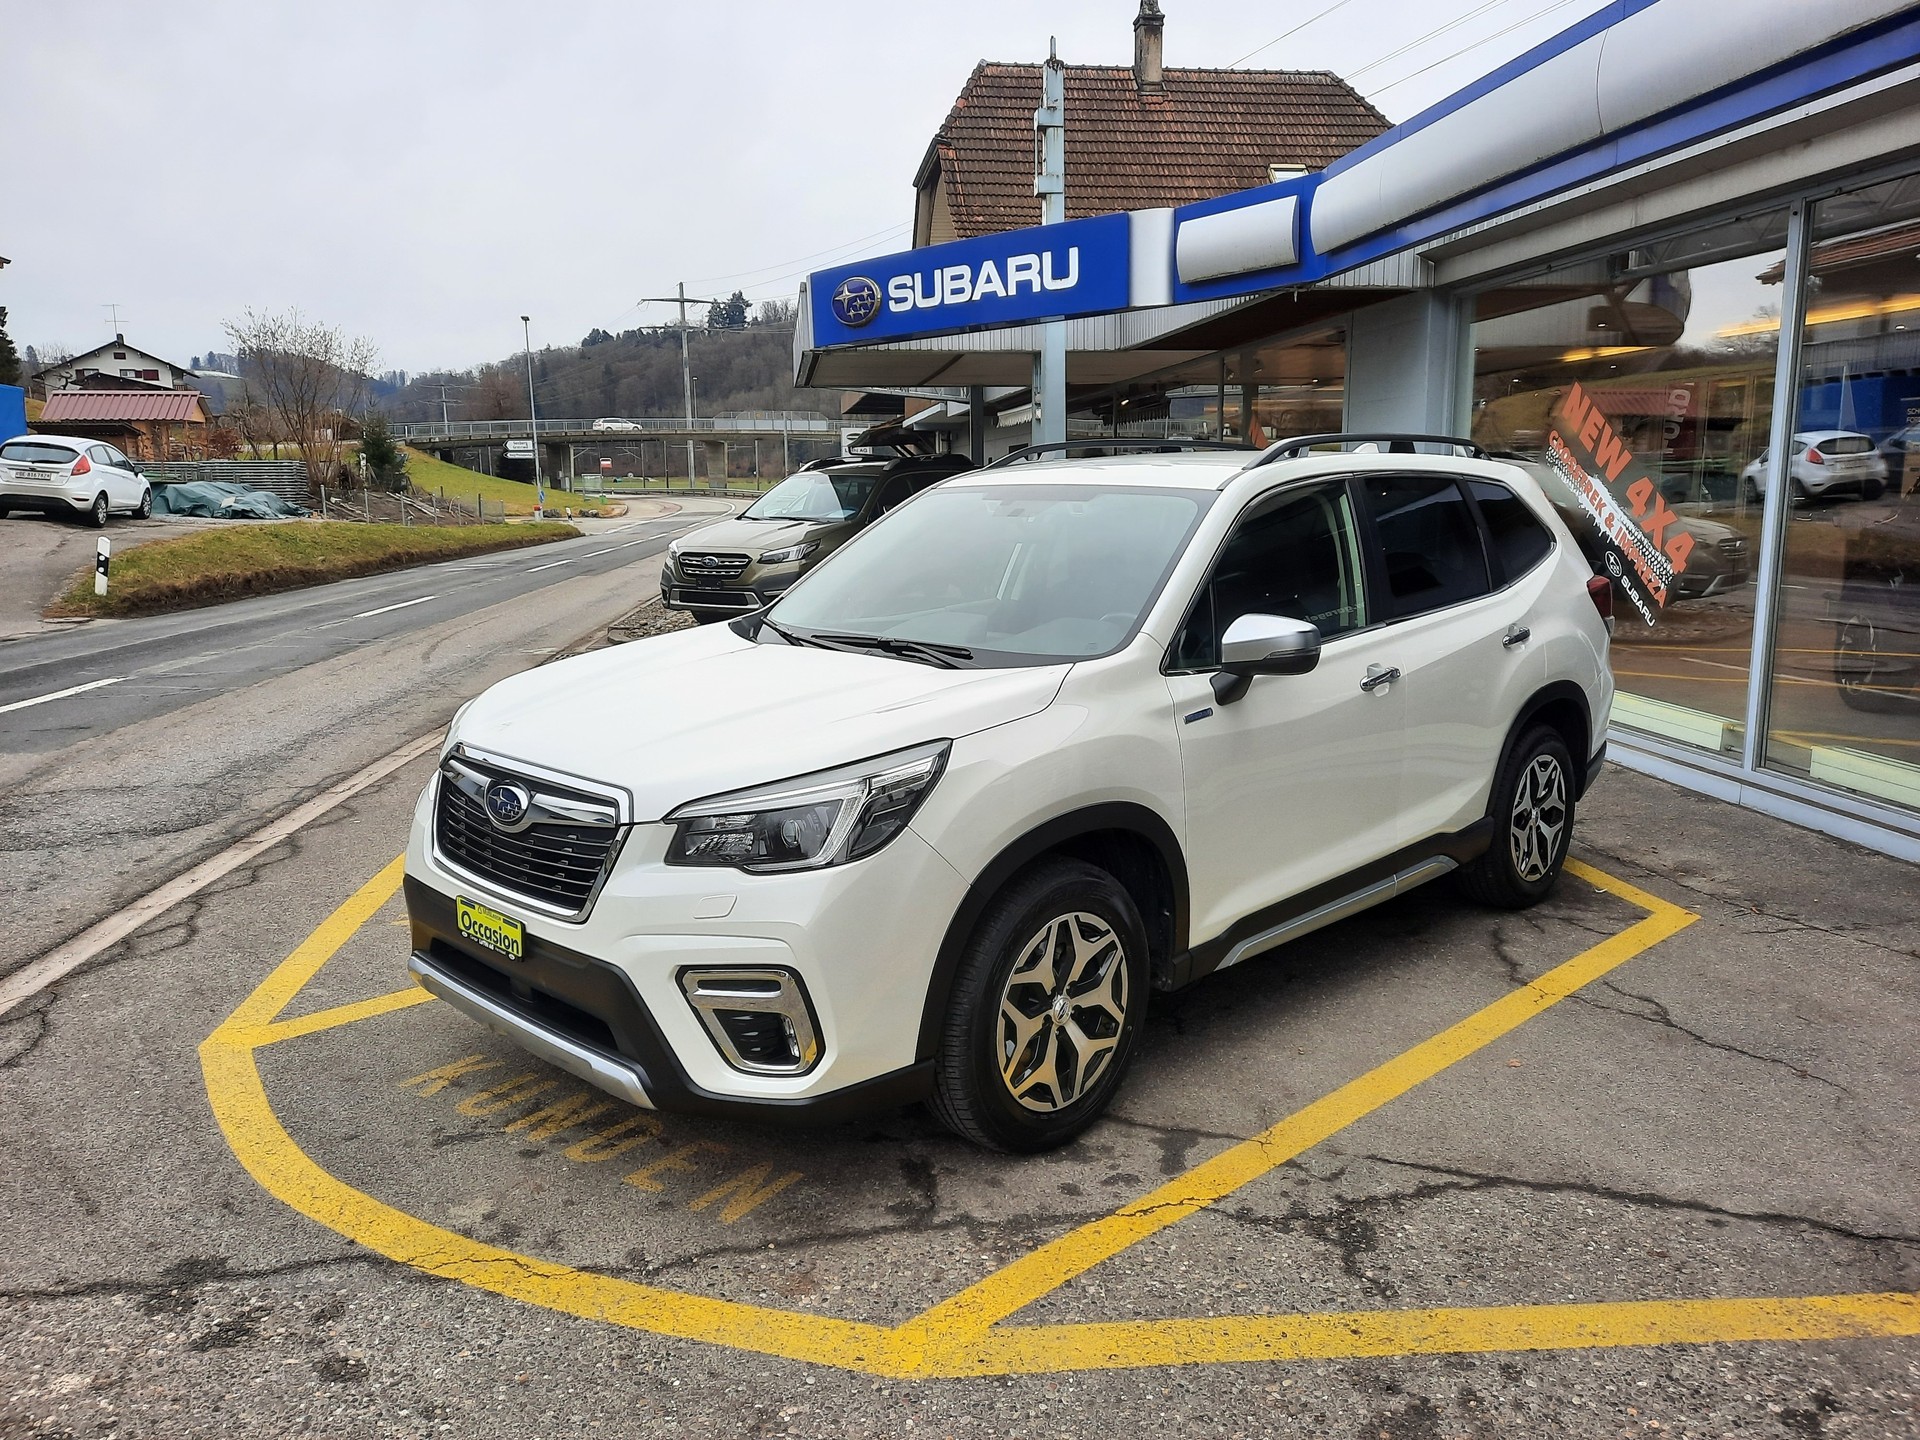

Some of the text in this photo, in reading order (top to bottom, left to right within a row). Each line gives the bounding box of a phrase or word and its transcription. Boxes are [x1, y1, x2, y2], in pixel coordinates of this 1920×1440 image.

[888, 246, 1079, 312] SUBARU
[1548, 429, 1669, 608] CROSSTREK & IMPREZA
[1561, 380, 1696, 575] NEW 4X4
[1620, 574, 1655, 627] SUBARU
[461, 910, 520, 955] Occasion
[399, 1053, 805, 1224] KUNDEN
